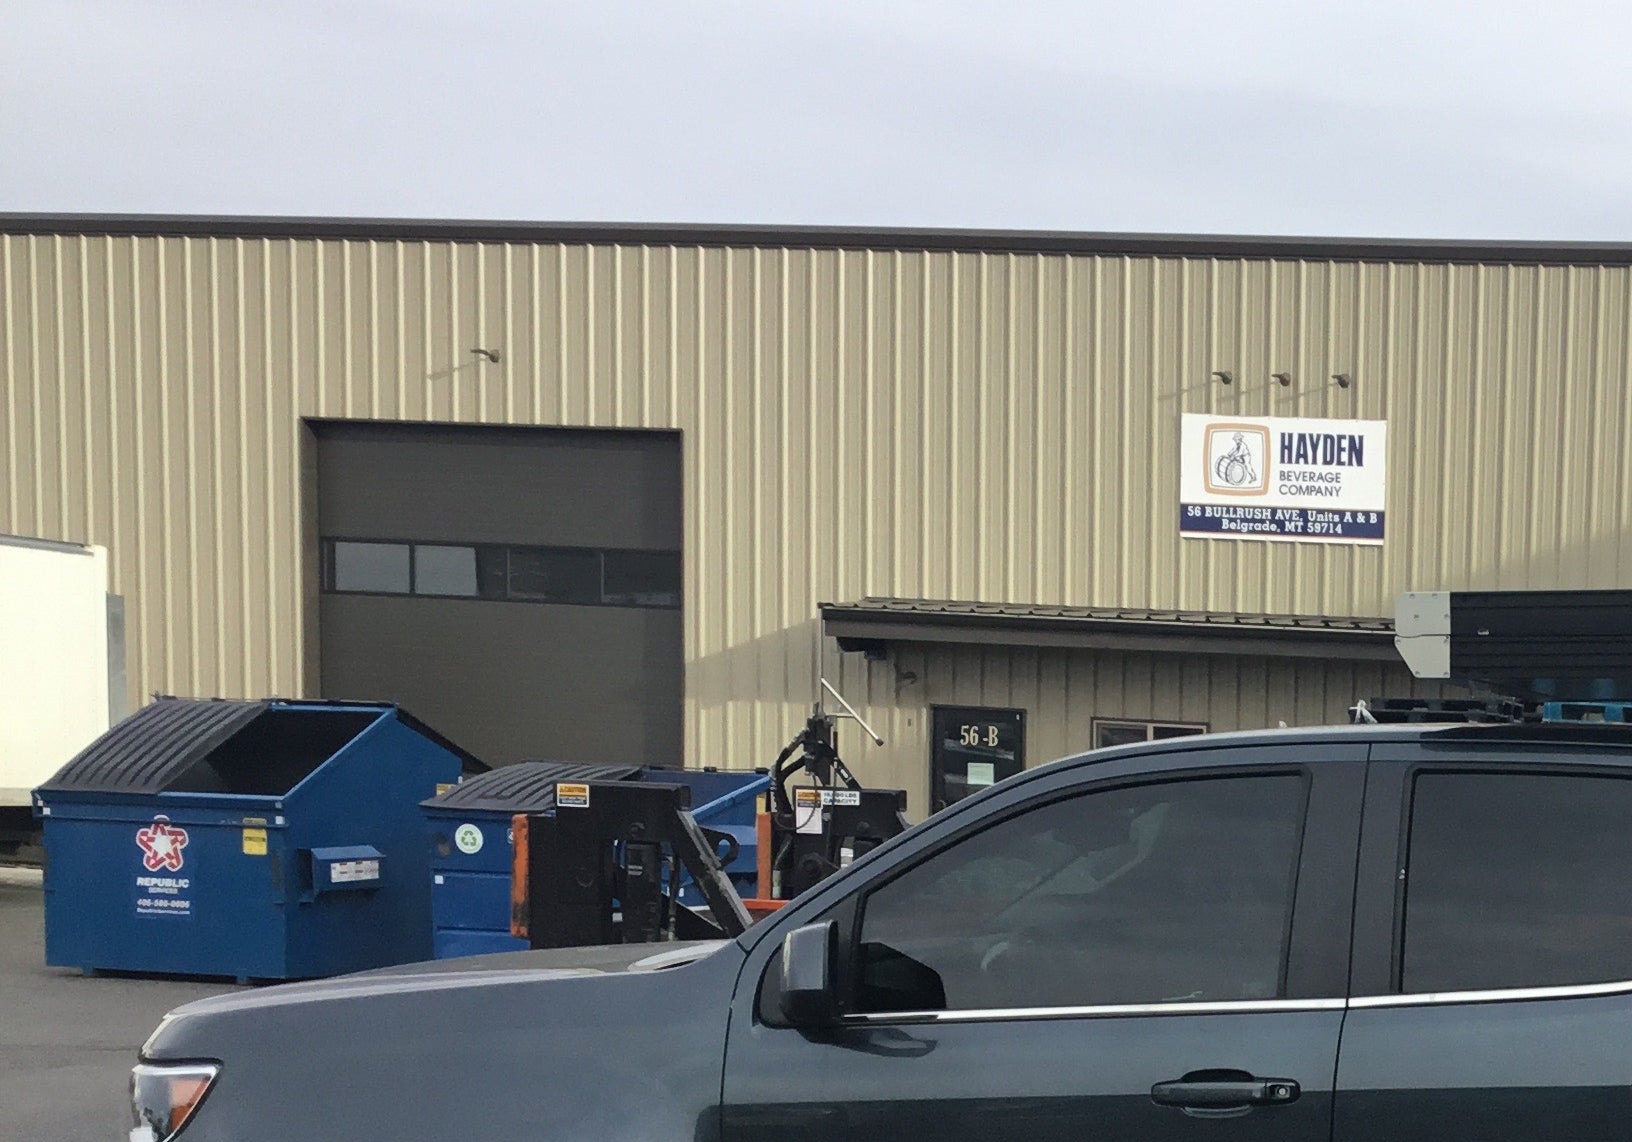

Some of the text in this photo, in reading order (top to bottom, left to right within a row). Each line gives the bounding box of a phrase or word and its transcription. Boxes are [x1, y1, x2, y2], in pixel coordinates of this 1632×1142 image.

[1279, 432, 1364, 467] HAYDEN
[1279, 470, 1341, 484] BEVERAGE
[1279, 484, 1342, 497] COMPANY
[1187, 506, 1202, 517] 56
[1205, 506, 1271, 520] BULLRUSH
[1307, 510, 1340, 523] Units
[1343, 512, 1353, 523] A
[1357, 512, 1366, 524] &
[1369, 512, 1378, 524] B
[1285, 521, 1303, 533] MT
[1307, 522, 1343, 534] 59714
[137, 877, 190, 888] REPUBLIC
